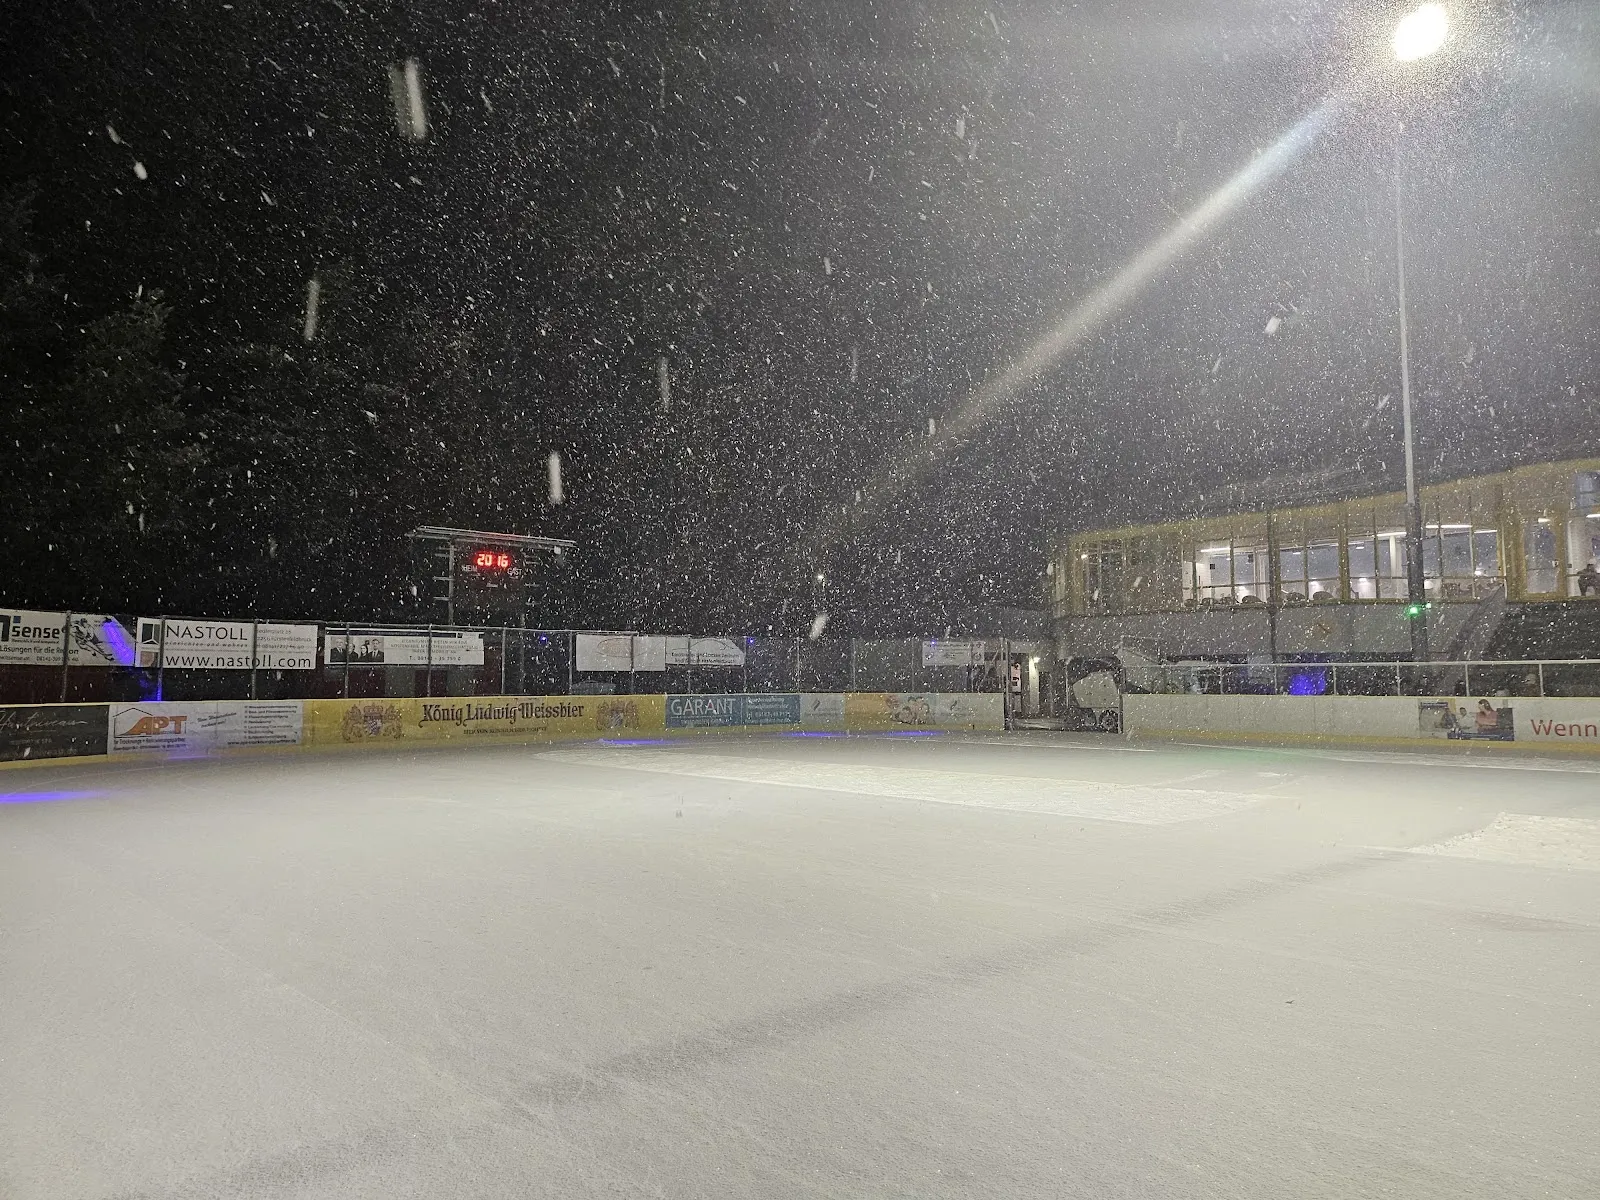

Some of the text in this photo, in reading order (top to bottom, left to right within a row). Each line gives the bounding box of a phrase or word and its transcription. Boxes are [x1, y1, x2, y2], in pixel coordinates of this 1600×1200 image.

[477, 554, 508, 568] 20 16
[12, 626, 60, 639] sense
[166, 625, 248, 641] NASTOLL
[166, 655, 311, 668] www.nastoll.com
[418, 702, 584, 728] König Ludwig Weissbier
[671, 698, 736, 716] GARANT
[118, 716, 187, 735] APT
[1531, 719, 1598, 737] Wenn
